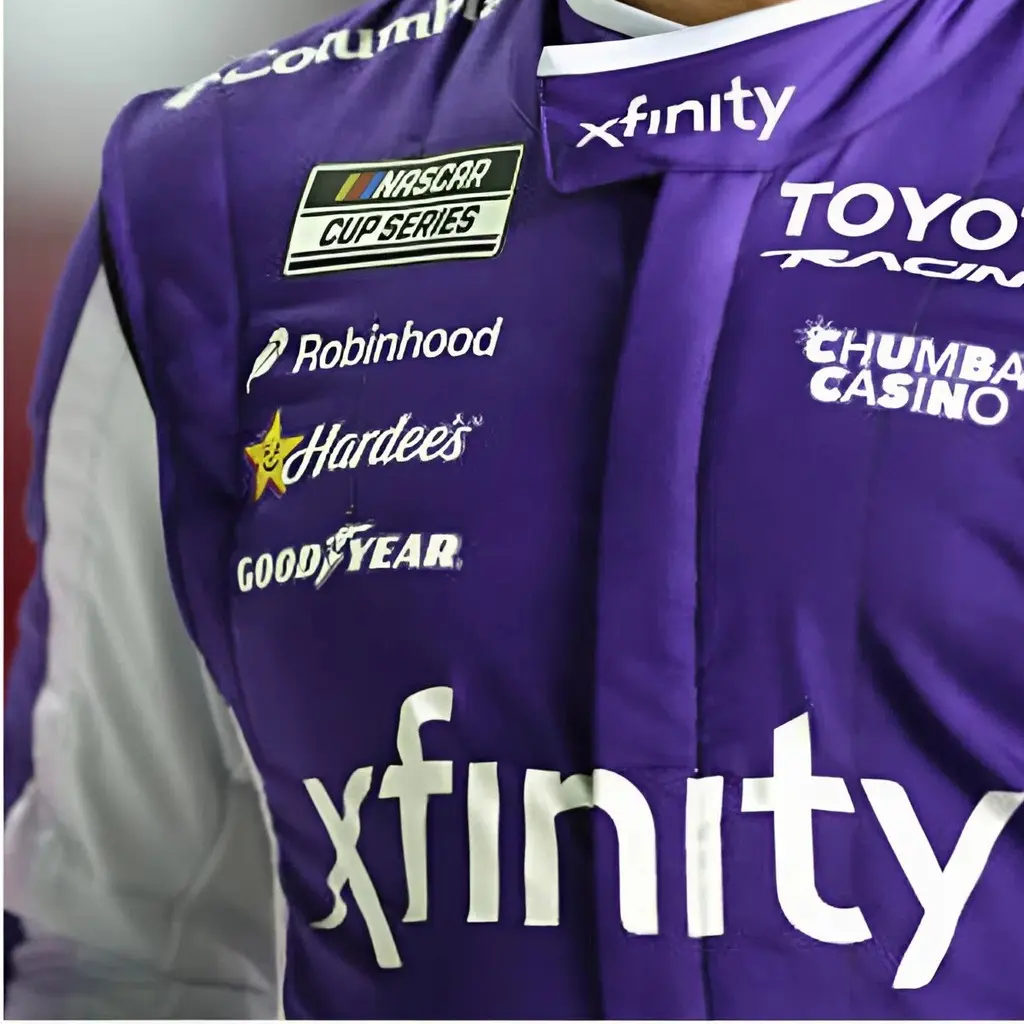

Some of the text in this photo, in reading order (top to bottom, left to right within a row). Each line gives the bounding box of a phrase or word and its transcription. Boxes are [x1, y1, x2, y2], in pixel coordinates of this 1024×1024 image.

[576, 76, 796, 149] xfinity
[377, 158, 491, 200] NASCAR
[319, 205, 480, 247] CUP SERIES
[292, 316, 504, 374] Robinhood
[809, 366, 1010, 426] CASINO
